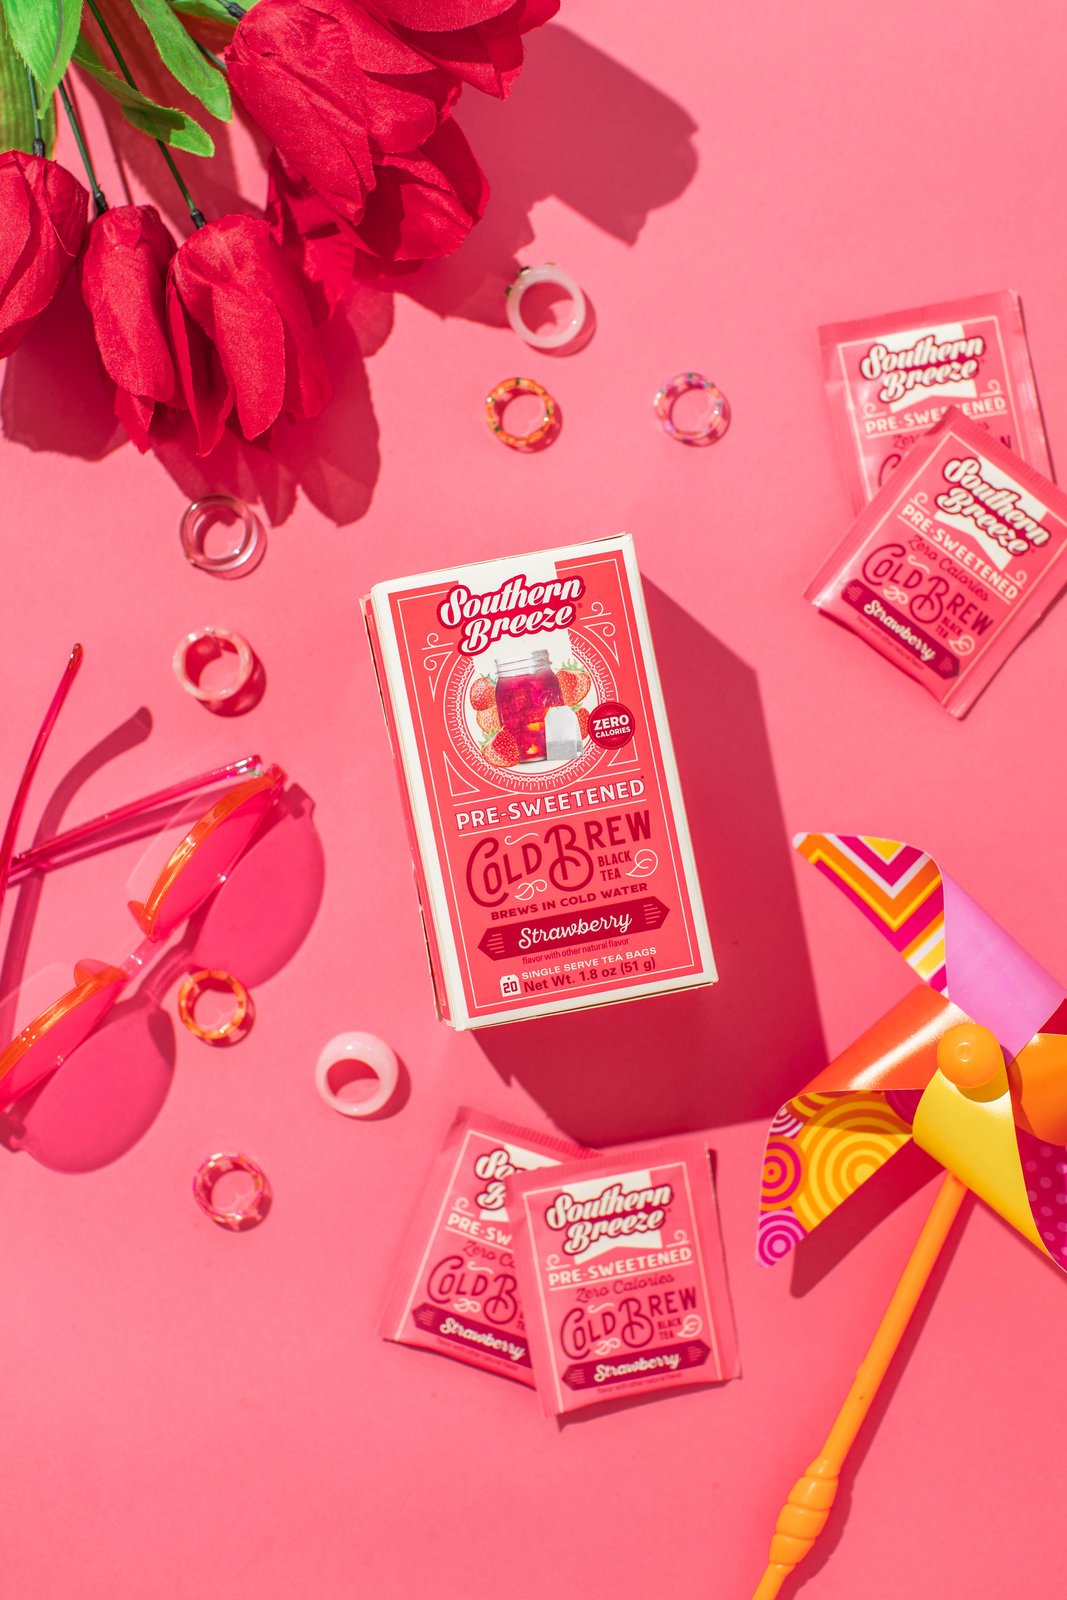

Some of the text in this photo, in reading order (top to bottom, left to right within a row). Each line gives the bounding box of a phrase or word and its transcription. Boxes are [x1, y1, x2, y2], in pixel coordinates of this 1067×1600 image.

[860, 335, 986, 381] Southern
[880, 359, 980, 403] Breeze
[864, 397, 1007, 433] PRE-SWEENED
[934, 486, 1032, 555] Breeze
[943, 457, 1050, 547] Southern
[901, 503, 1020, 601] PRE-SWEETENED
[938, 558, 990, 602] Calories
[437, 575, 585, 627] Southern
[457, 601, 574, 656] Breeze
[863, 599, 937, 662] Strawberry
[593, 714, 629, 731] ZERO
[595, 726, 631, 739] CALORIES
[465, 809, 651, 908] COLD BREW
[597, 850, 632, 868] BLACK
[600, 868, 622, 883] TEA
[491, 882, 649, 921] BREWS IN COLD WATER
[518, 912, 633, 949] Strawberry
[521, 946, 657, 980] SINGLE SERVE TEA BAGS
[522, 937, 630, 965] flavor with other natural flavor
[502, 980, 518, 994] 20
[523, 956, 656, 993] Net Wt. 1.8 oz (51 g)
[545, 1182, 674, 1231] Southern
[563, 1207, 667, 1256] Breeze
[548, 1248, 692, 1287] PRE-SWEETENED
[613, 1273, 675, 1295] Calories
[439, 1316, 526, 1361] Strawberry
[593, 1353, 682, 1383] Strawberry
